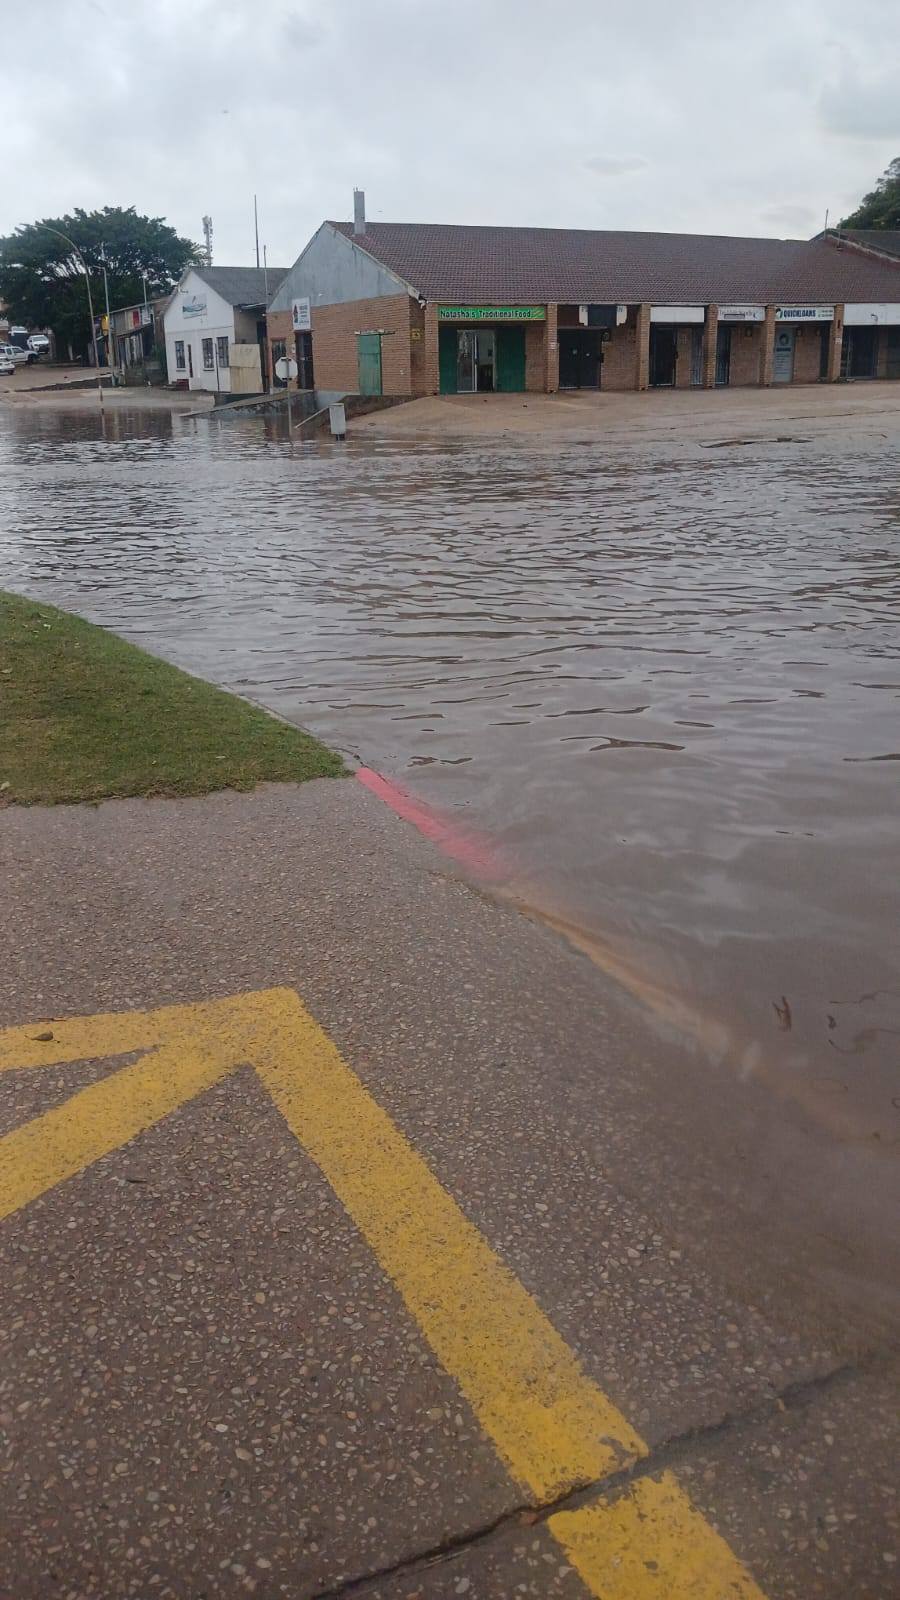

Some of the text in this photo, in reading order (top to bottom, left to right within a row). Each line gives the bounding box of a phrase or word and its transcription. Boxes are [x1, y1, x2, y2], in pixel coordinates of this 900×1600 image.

[479, 310, 513, 318] Traditional
[515, 310, 531, 318] Food
[783, 308, 816, 318] QUICKLOANS
